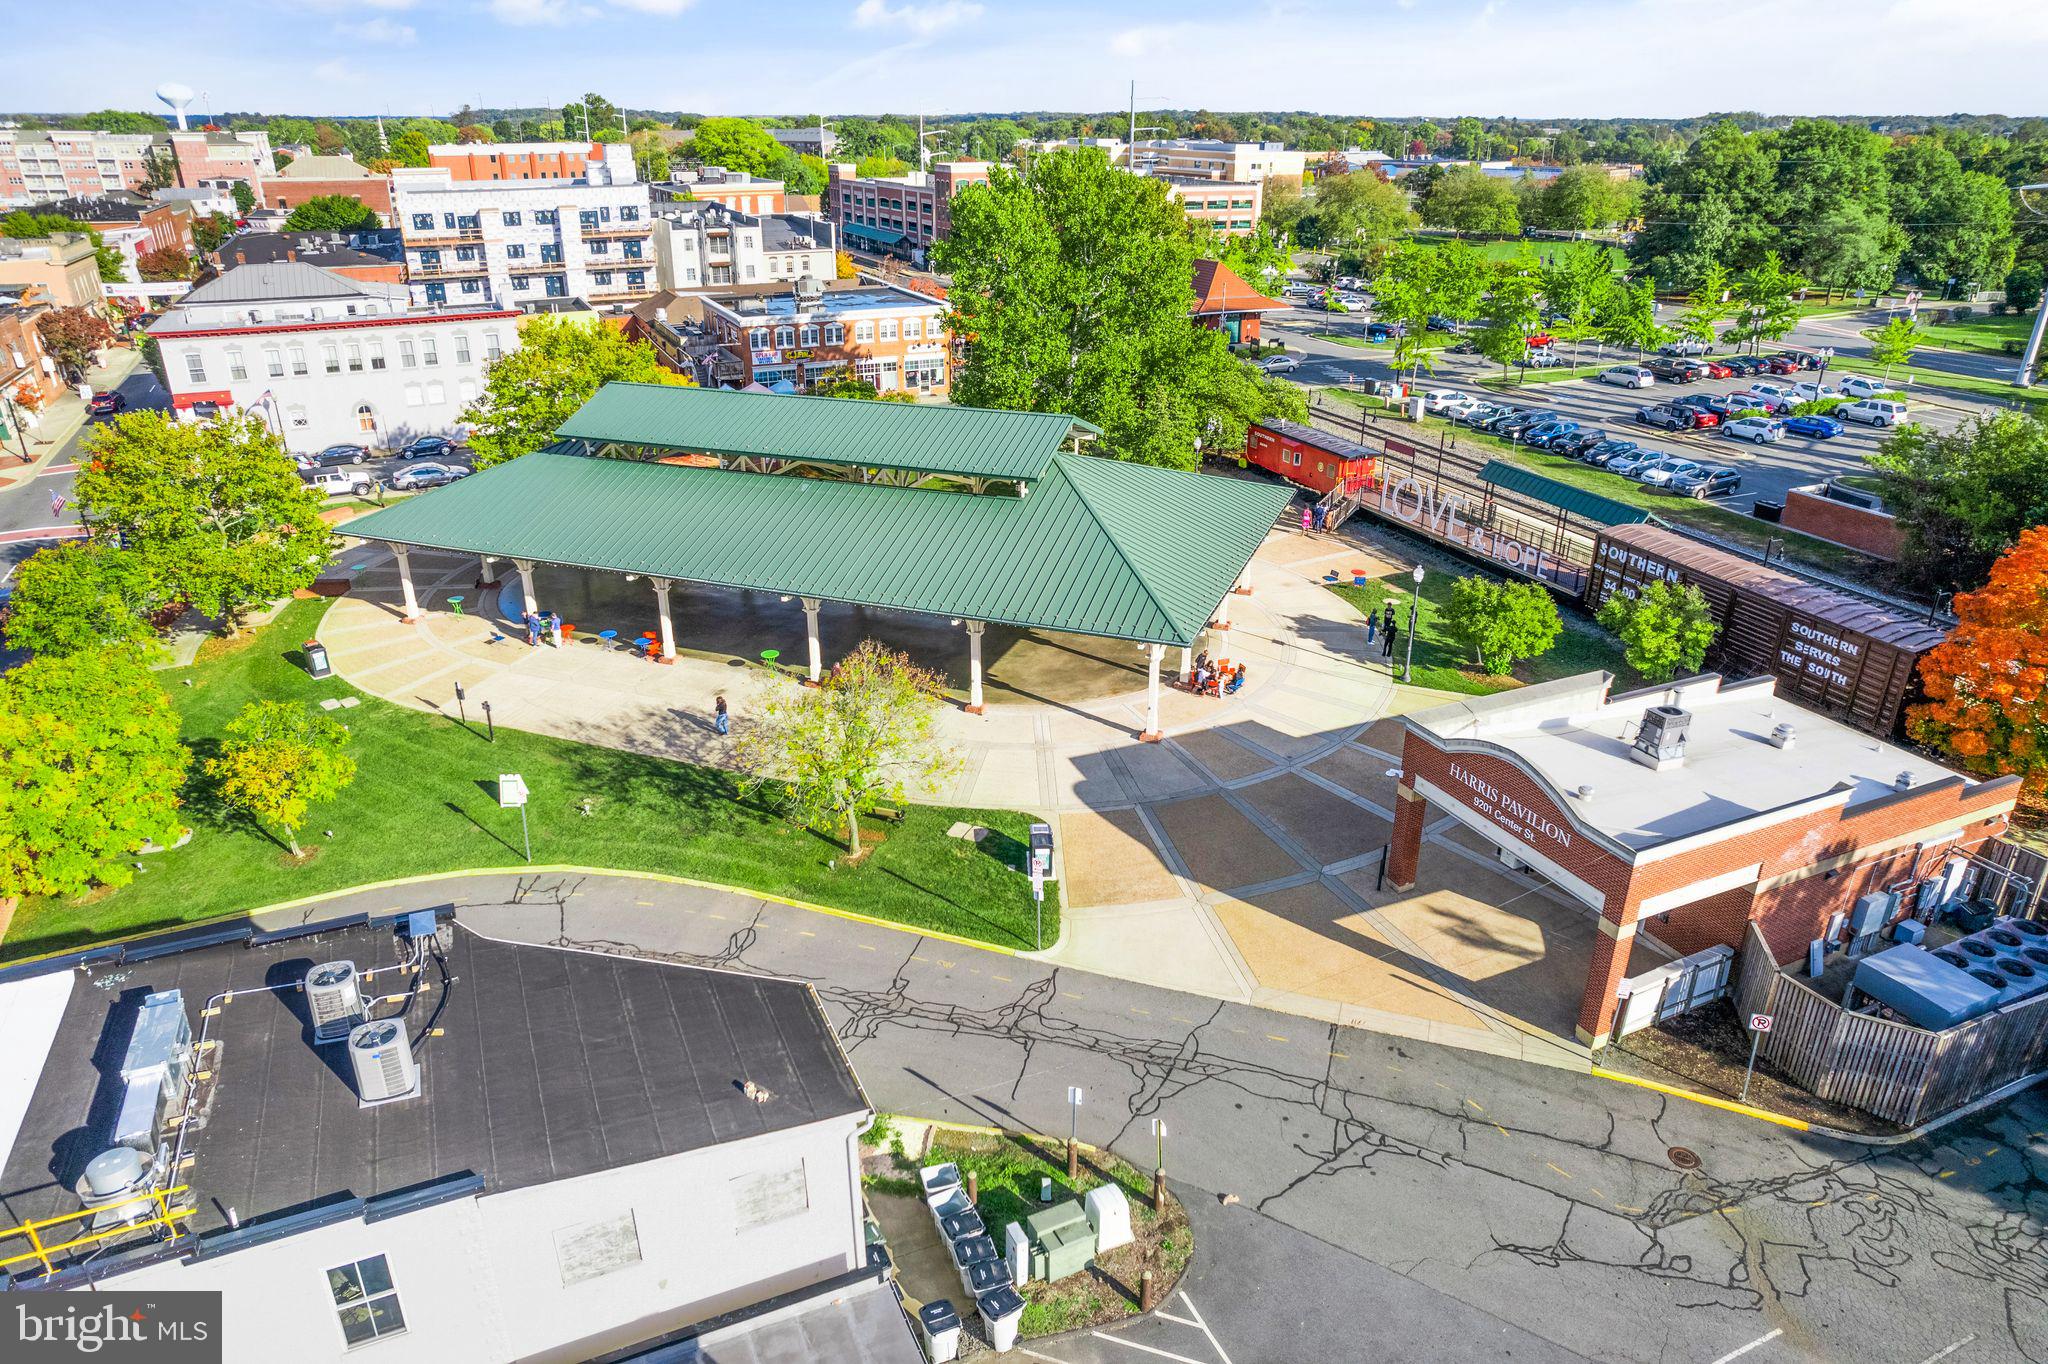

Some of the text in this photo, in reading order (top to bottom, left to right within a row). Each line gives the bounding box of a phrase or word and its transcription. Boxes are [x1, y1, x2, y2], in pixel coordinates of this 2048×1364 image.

[1380, 469, 1470, 546] LOVE
[1492, 533, 1551, 580] HOPE
[1600, 542, 1679, 584] SOUTHERN
[1791, 622, 1859, 656] SOUTHERN
[1795, 641, 1840, 666] SERVES
[1780, 650, 1848, 686] THE SOUTH
[1449, 763, 1571, 848] HARRIS PAVILION
[1473, 796, 1536, 843] 9201 Center St.
